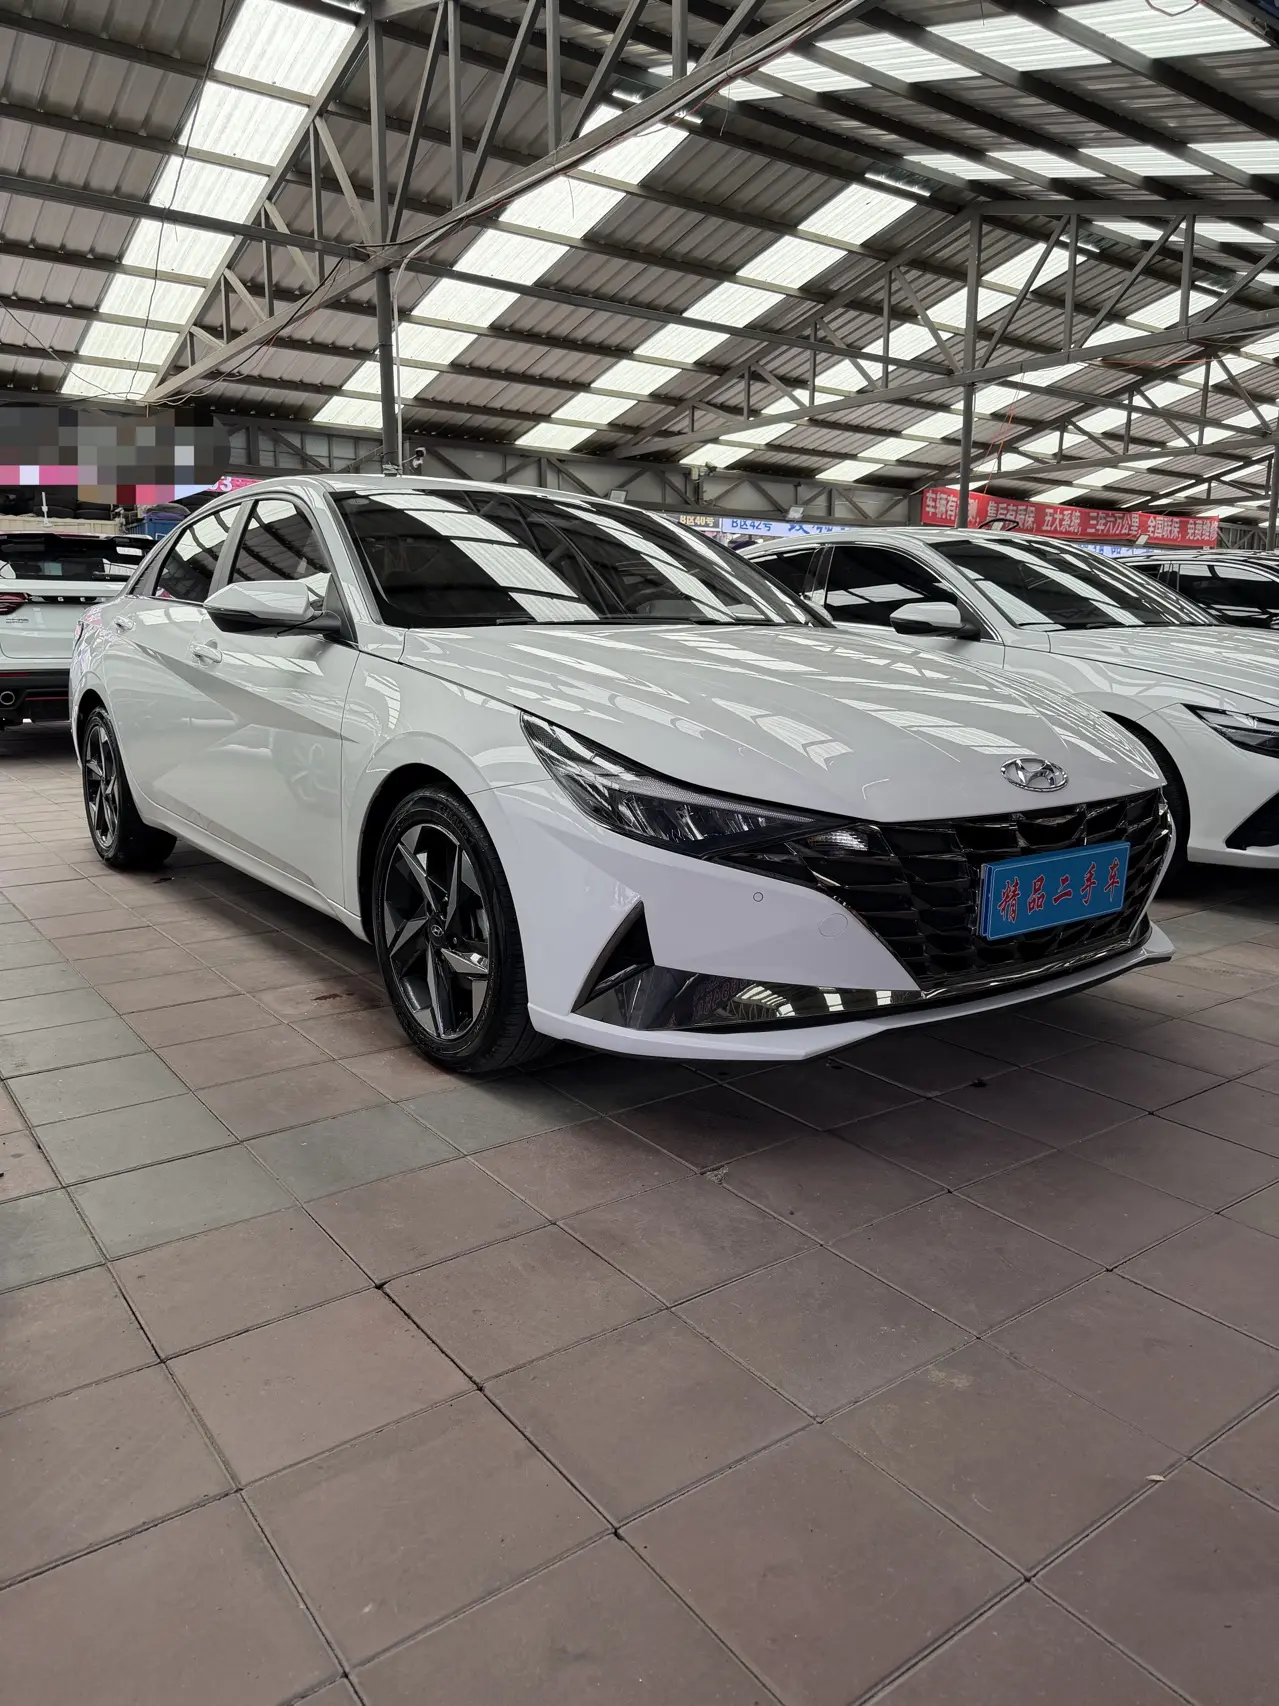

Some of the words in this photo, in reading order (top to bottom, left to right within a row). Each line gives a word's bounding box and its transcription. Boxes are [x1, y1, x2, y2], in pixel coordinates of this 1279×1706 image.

[997, 857, 1120, 923] 精品二手车
